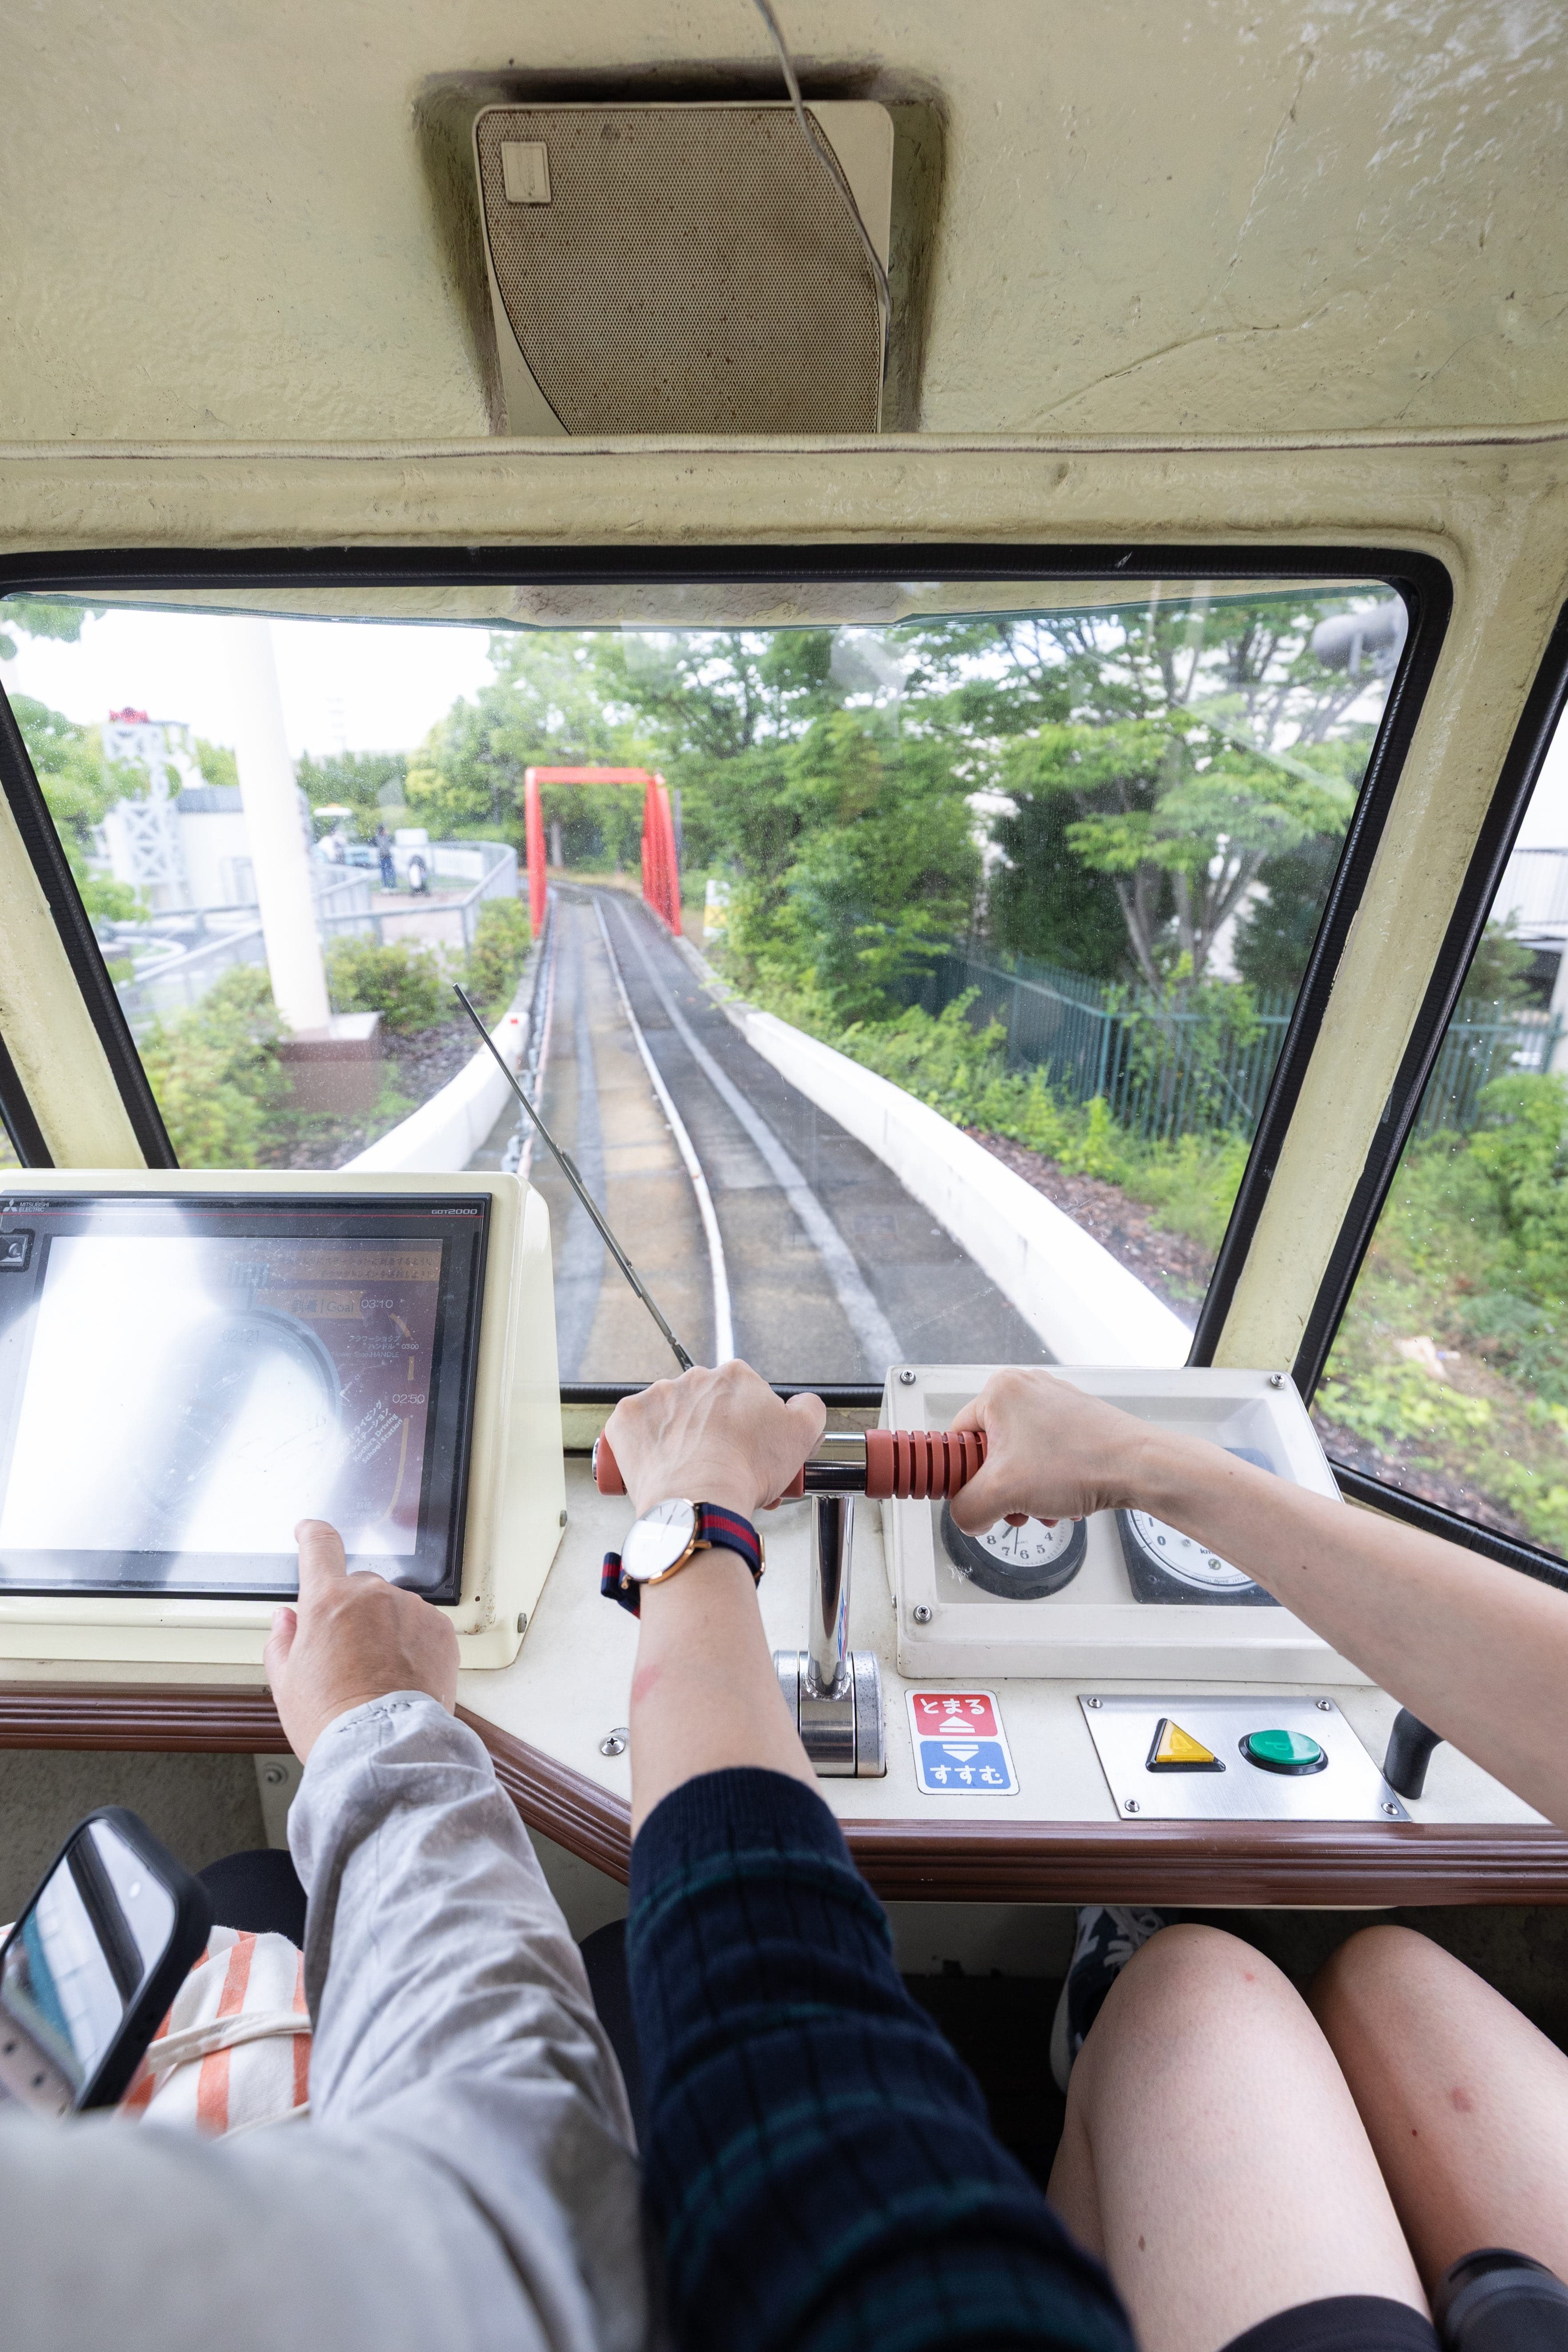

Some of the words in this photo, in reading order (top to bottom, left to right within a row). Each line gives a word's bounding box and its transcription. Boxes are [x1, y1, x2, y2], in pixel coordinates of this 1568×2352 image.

[327, 1301, 354, 1312] Goal
[360, 1299, 393, 1308] 03:10
[348, 1335, 400, 1343] フラワーショップ
[392, 1394, 425, 1404] 02:50
[375, 1413, 399, 1437] Driving
[362, 1442, 382, 1464] School
[381, 1419, 404, 1442] Station
[987, 1535, 996, 1545] 8
[1044, 1532, 1054, 1541] 4
[1157, 1536, 1166, 1546] 0
[1001, 1546, 1010, 1556] 7
[1036, 1544, 1046, 1554] 5
[1020, 1550, 1029, 1560] 6
[920, 1698, 985, 1715] とまる
[929, 1764, 1004, 1785] すすむ
